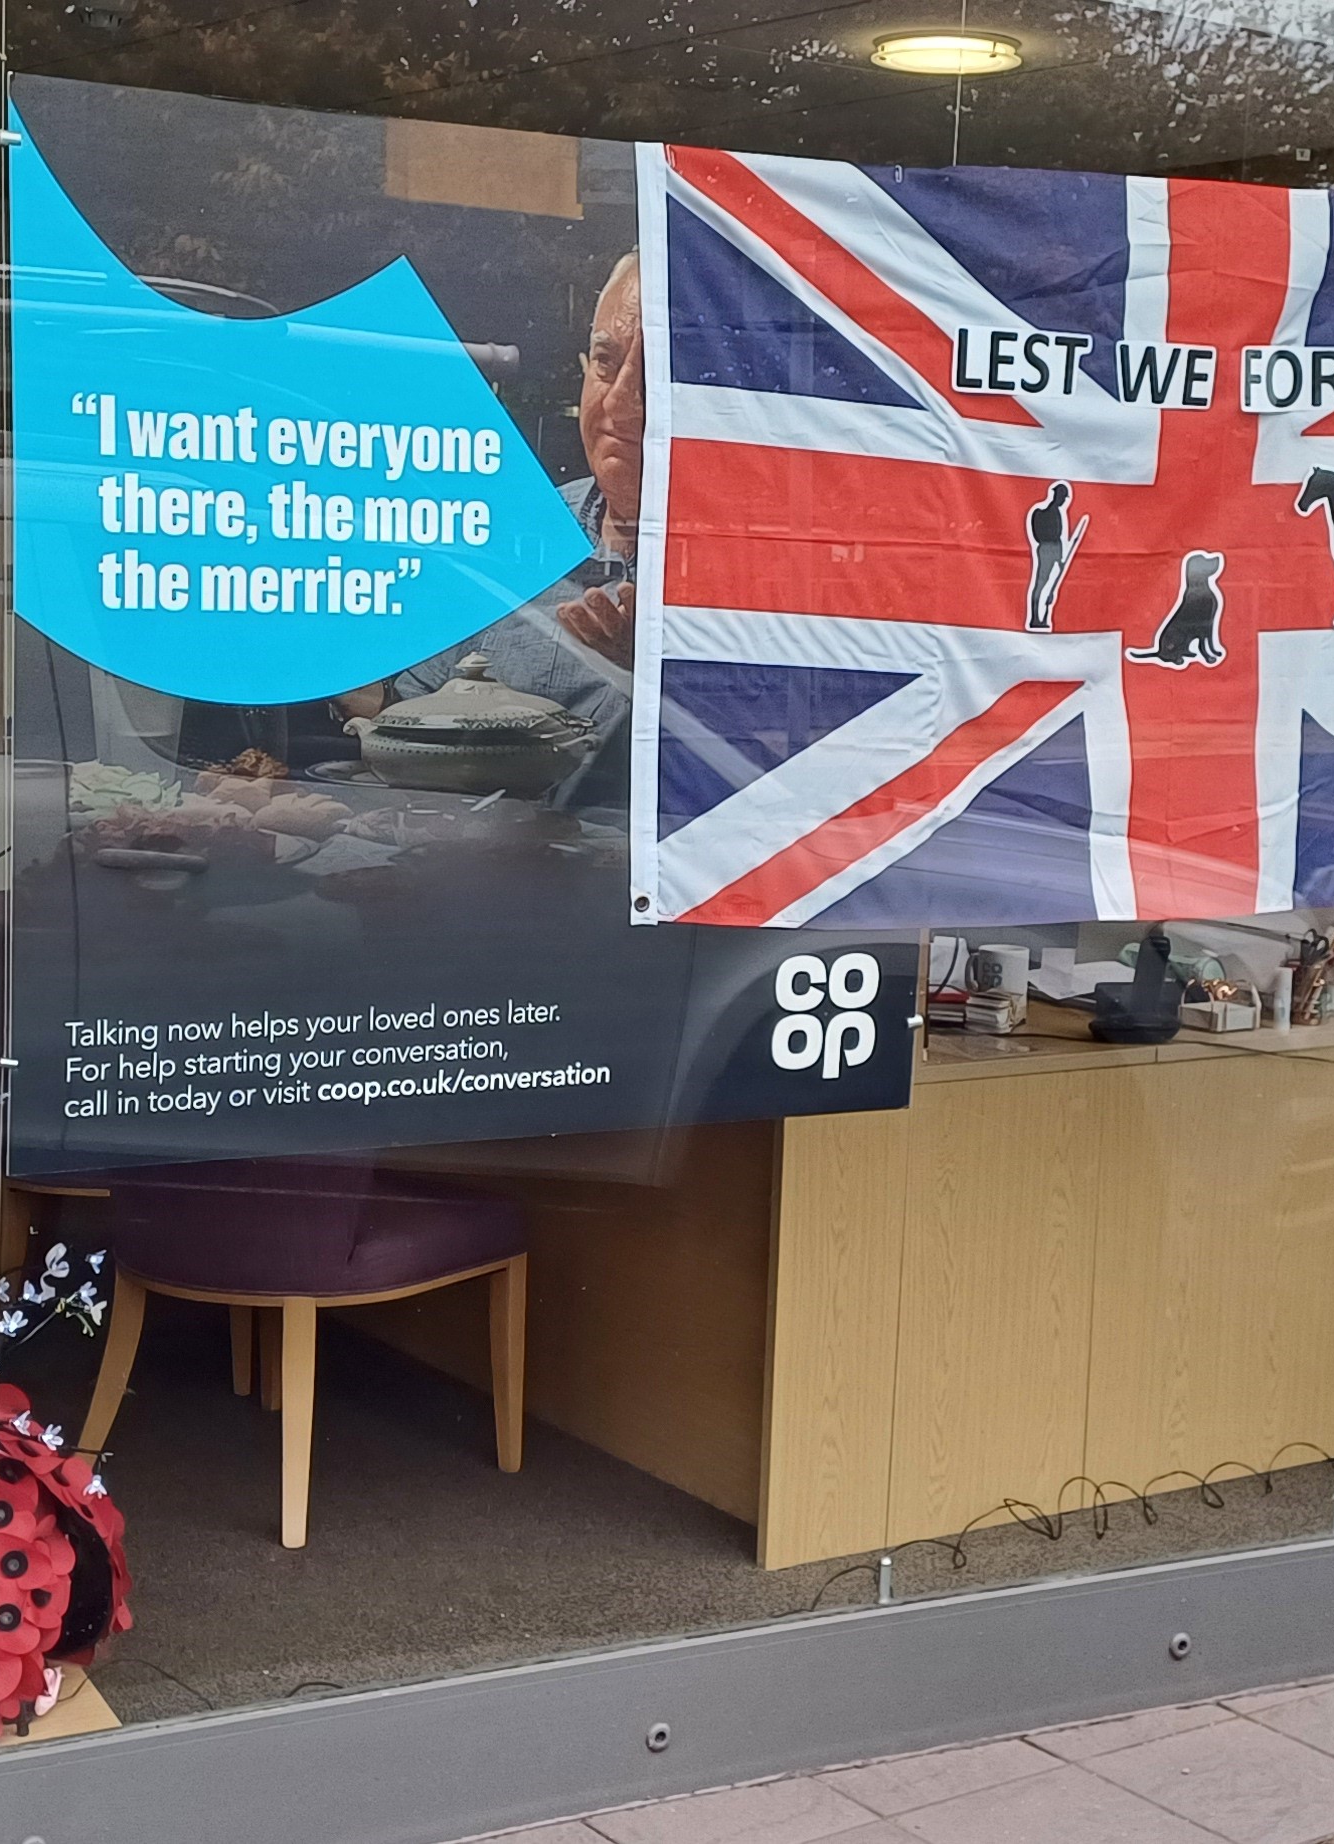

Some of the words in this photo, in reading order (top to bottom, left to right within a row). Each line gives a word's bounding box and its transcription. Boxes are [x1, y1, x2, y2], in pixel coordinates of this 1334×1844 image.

[958, 328, 1089, 395] LEST
[1118, 343, 1213, 406] WE
[126, 406, 258, 463] want
[267, 417, 501, 480] everyone
[98, 473, 258, 545] there,
[268, 480, 353, 541] the
[364, 496, 490, 546] more
[98, 549, 189, 611] the
[64, 1019, 158, 1050] Talking
[168, 1022, 223, 1042] now
[231, 1011, 299, 1043] helps
[306, 1014, 362, 1041] your
[369, 1003, 435, 1031] loved
[443, 1007, 500, 1028] ones
[508, 999, 561, 1024] later.
[64, 1090, 108, 1118] call
[117, 1090, 139, 1114] in
[148, 1084, 221, 1115] today
[229, 1088, 256, 1107] or
[263, 1080, 311, 1105] visit
[318, 1062, 610, 1105] coop.co.uk/conversation
[66, 1057, 111, 1082] For
[119, 1052, 176, 1084] help
[184, 1048, 281, 1077] starting
[289, 1049, 346, 1076] your
[352, 1036, 508, 1066] conversation,
